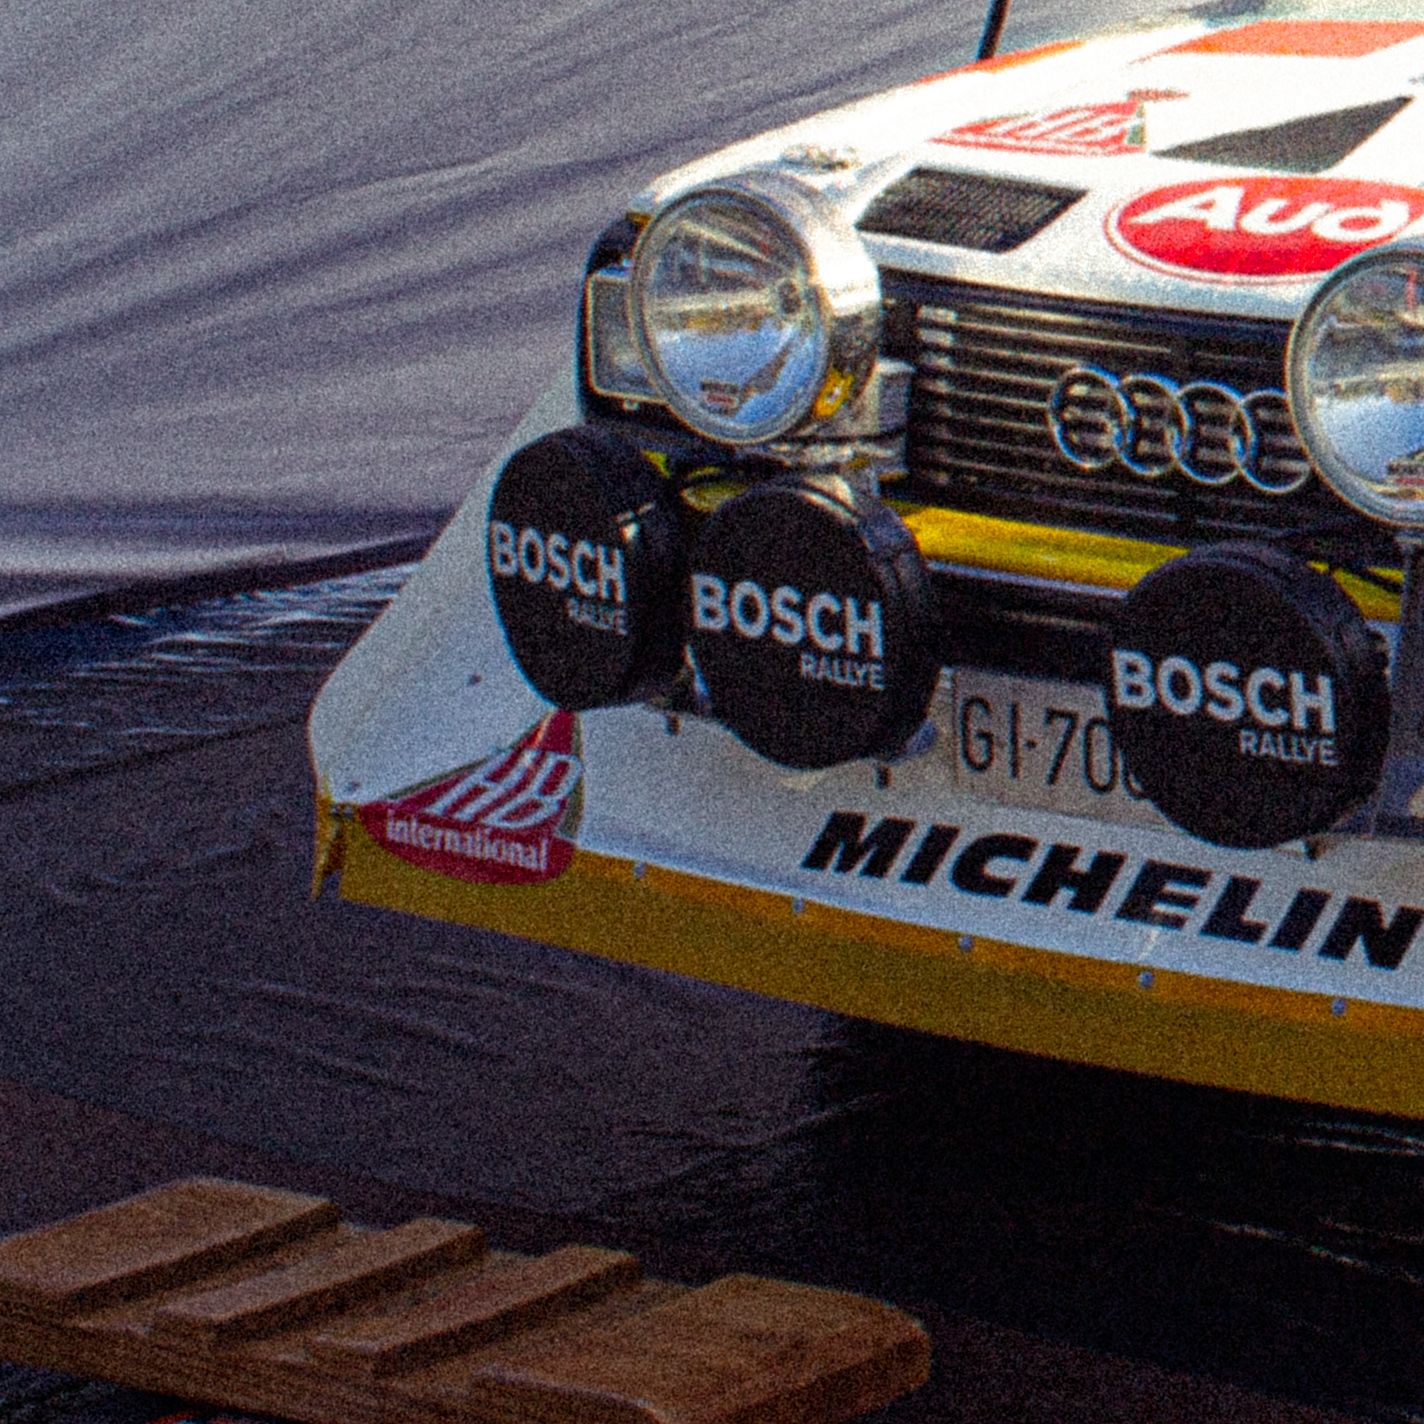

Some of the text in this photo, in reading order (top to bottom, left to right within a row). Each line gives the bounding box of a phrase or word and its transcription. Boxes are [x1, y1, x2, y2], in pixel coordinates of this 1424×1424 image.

[487, 518, 627, 606] BOSCH
[567, 595, 630, 637] RALLYE
[691, 573, 886, 659] BOSCH
[800, 654, 886, 692] RALLYE
[1112, 648, 1336, 733] BOSCH
[961, 694, 1150, 802] GI-70
[1238, 727, 1340, 767] RALLYE
[385, 800, 550, 872] international
